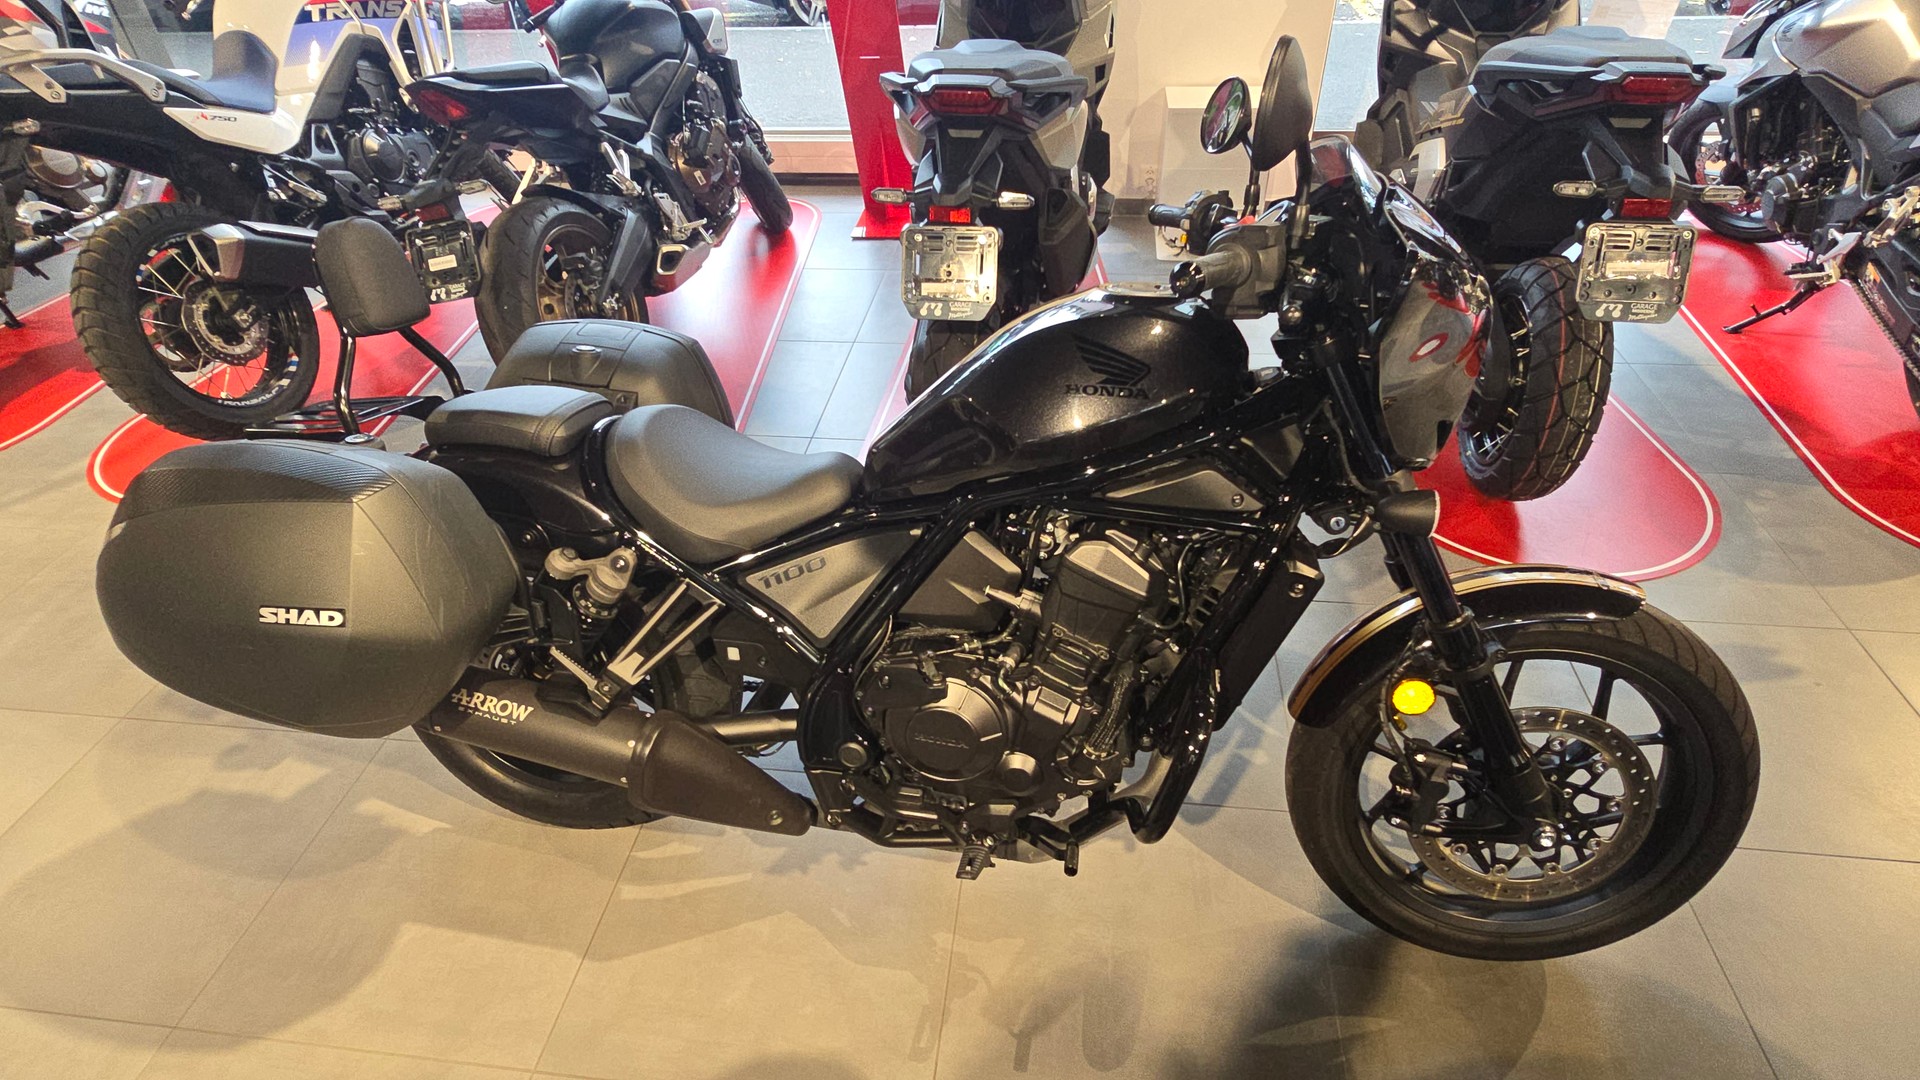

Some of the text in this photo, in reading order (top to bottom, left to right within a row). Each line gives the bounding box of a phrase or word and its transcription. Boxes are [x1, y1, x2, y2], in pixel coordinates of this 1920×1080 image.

[1064, 384, 1150, 400] HONDA
[758, 556, 826, 589] 1100
[259, 607, 344, 627] SHAD
[451, 688, 534, 722] ARROW
[458, 706, 517, 725] EXHAUST
